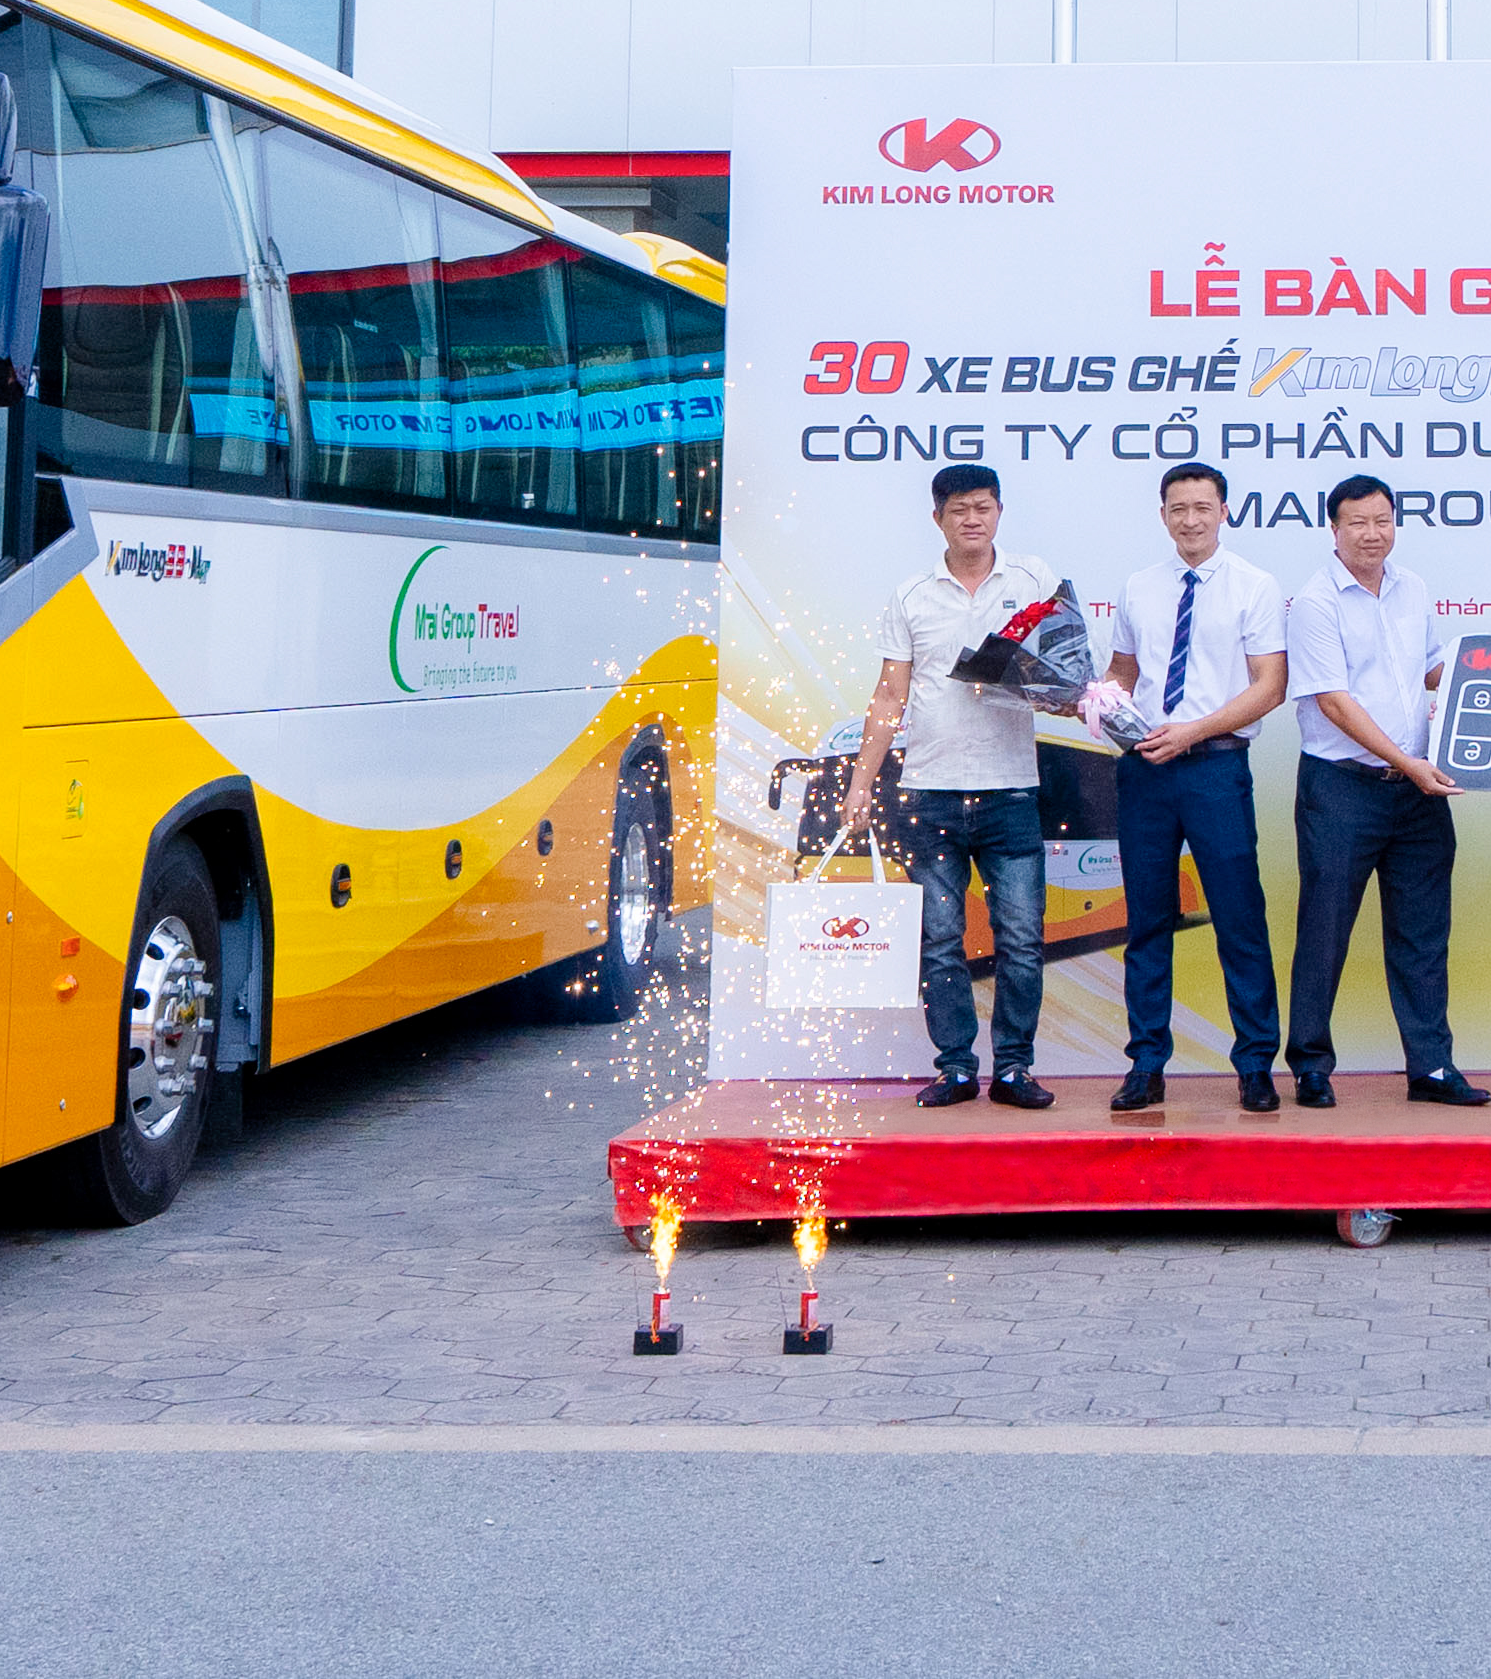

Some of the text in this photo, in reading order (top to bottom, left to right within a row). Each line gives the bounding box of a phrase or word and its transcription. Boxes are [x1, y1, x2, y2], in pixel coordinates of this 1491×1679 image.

[823, 185, 1054, 204] KIM LONG MOTOR
[1150, 242, 1240, 317] LỄ
[1265, 257, 1426, 316] BÀN
[803, 340, 911, 395] 30
[916, 357, 993, 393] XE
[1002, 357, 1116, 392] BUS
[1128, 338, 1241, 392] GHẾ
[802, 415, 984, 461] CÔNG
[1005, 424, 1092, 460] TY
[1112, 407, 1198, 460] CỔ
[1222, 407, 1403, 459] PHẦN
[1227, 491, 1325, 529] MAI
[442, 603, 476, 654] Group
[478, 603, 520, 639] Travel
